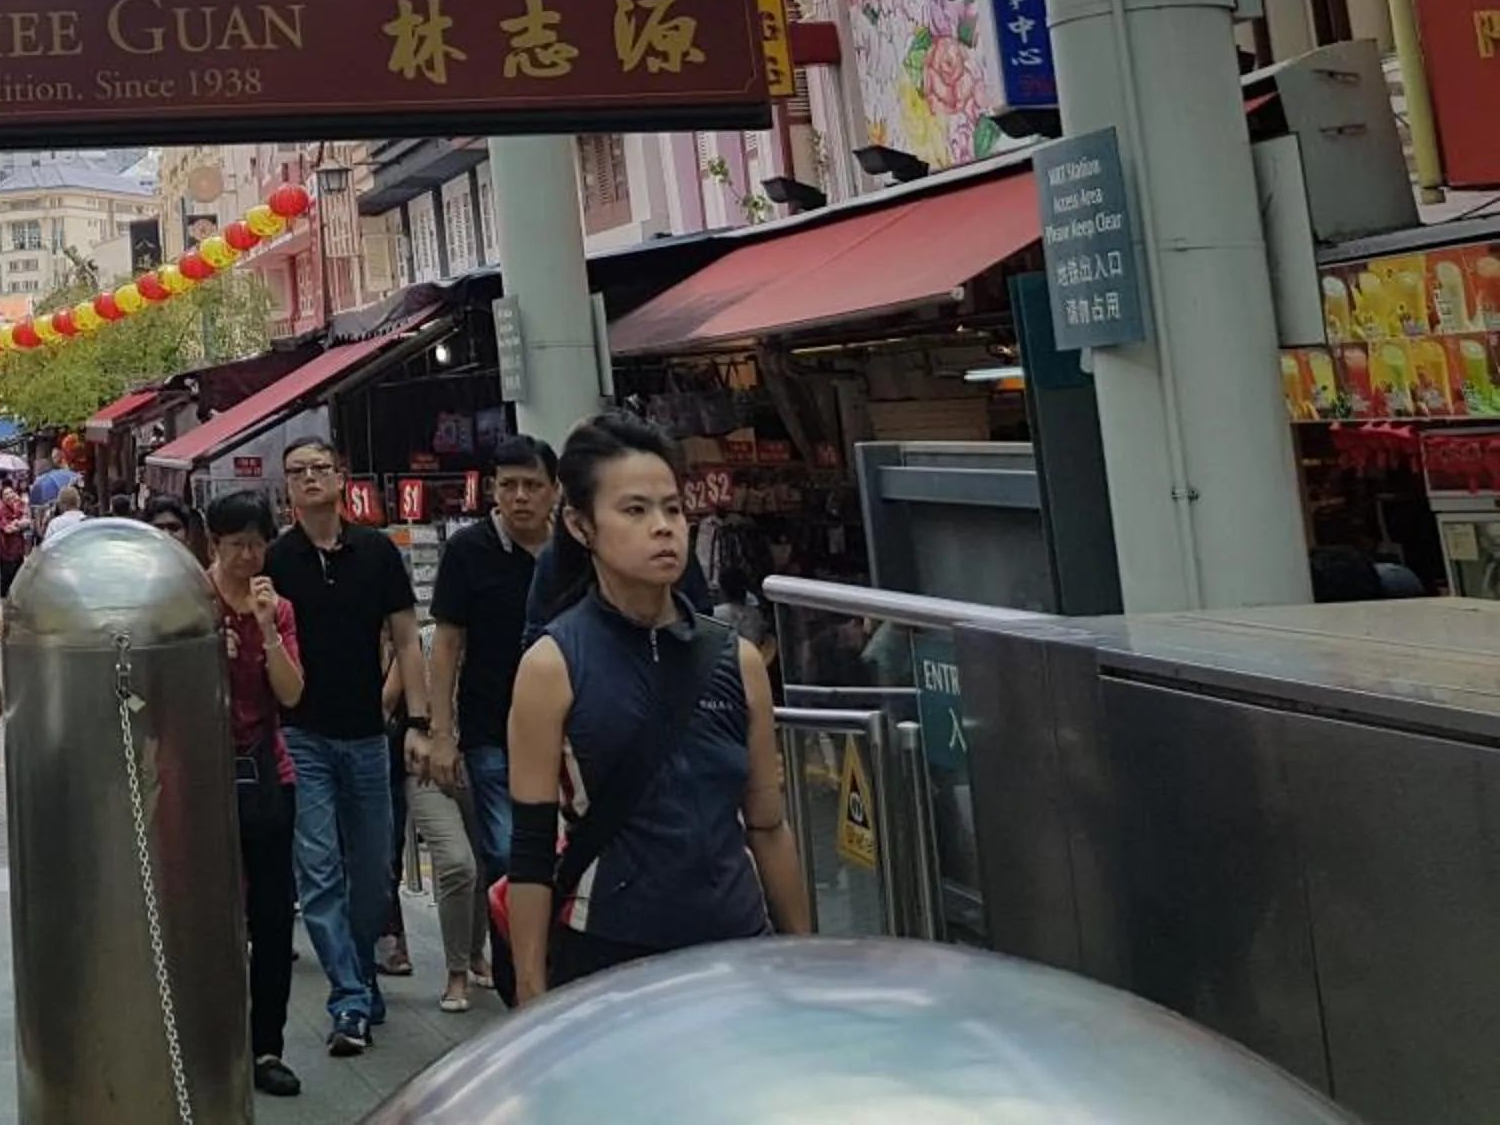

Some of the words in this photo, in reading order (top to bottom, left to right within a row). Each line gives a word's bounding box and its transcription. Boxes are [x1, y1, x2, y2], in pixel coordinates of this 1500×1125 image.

[95, 70, 176, 100] Since
[187, 68, 264, 98] 1938
[1066, 156, 1101, 182] Station
[1053, 193, 1079, 213] Access
[1080, 187, 1104, 207] Area
[1071, 218, 1095, 240] Keep
[1095, 210, 1124, 232] Clear
[351, 483, 371, 516] $1
[403, 480, 421, 516] $1
[706, 471, 731, 505] $2
[923, 659, 960, 696] ENTR
[948, 707, 967, 753] 入
